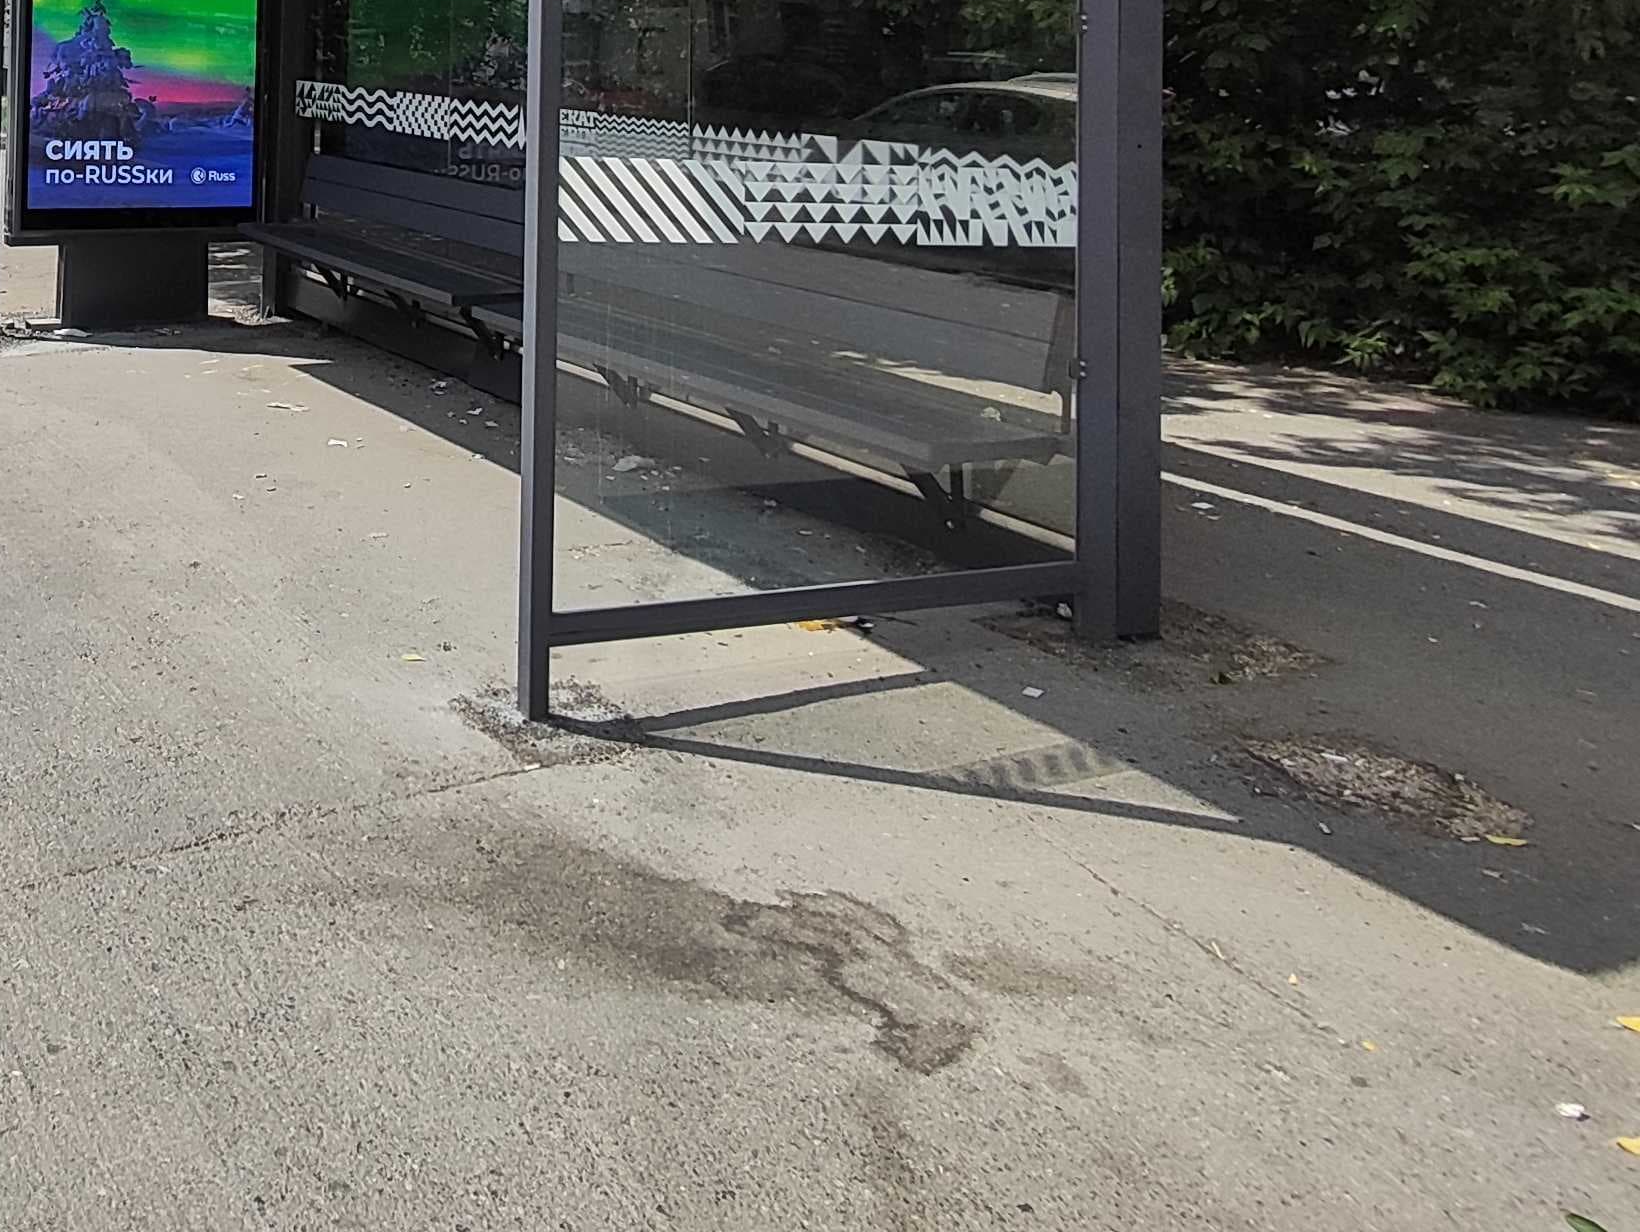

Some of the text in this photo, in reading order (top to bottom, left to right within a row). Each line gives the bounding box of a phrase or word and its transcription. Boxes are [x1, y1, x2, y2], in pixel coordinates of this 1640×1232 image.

[45, 139, 134, 161] СИЯТЬ
[45, 164, 174, 184] по-RUSSки
[208, 170, 236, 182] Russ
